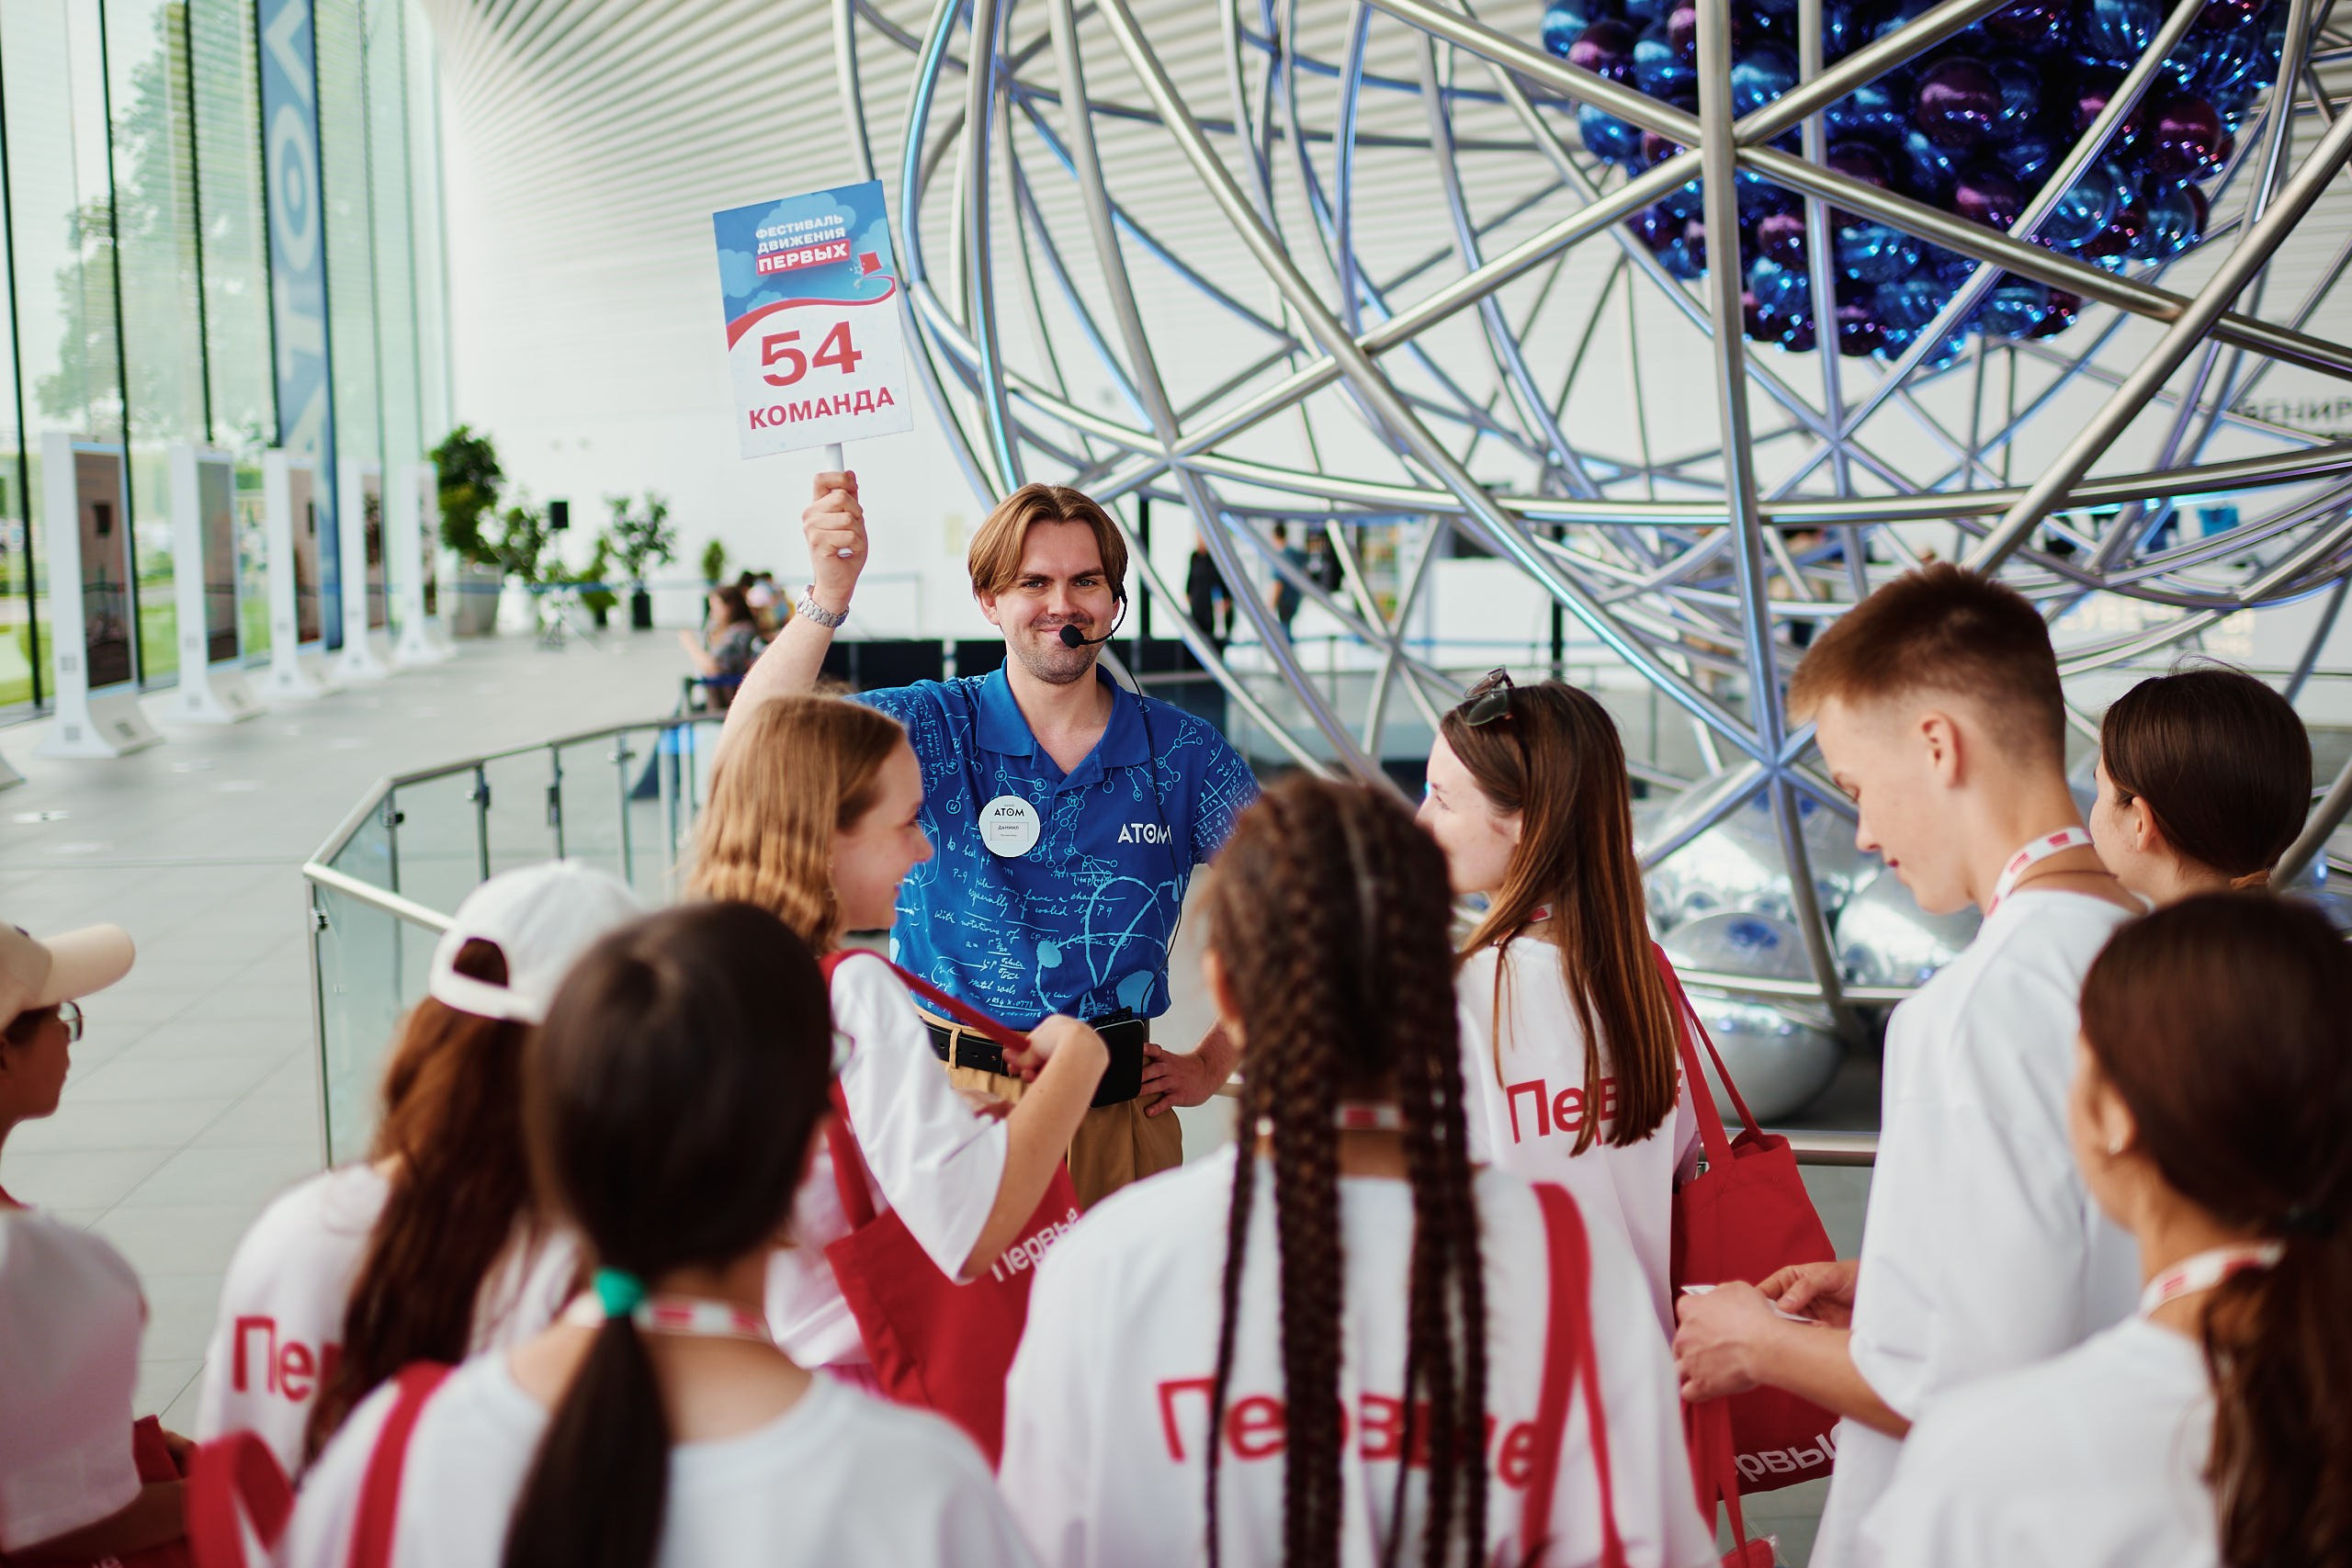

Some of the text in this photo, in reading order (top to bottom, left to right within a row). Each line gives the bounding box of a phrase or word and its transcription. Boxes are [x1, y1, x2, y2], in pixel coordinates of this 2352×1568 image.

[755, 214, 843, 239] ФЕСТИВАЛЬ
[757, 227, 846, 254] ДВИЖЕНИЯ
[758, 243, 847, 272] ПЕРВЫХ
[762, 321, 863, 387] 54
[749, 387, 895, 430] КОМАНДА
[2236, 398, 2352, 421] ВЕНИР
[994, 807, 1024, 817] АТОМ
[1117, 823, 1172, 844] АТОМ
[1735, 1423, 1840, 1483] рвы
